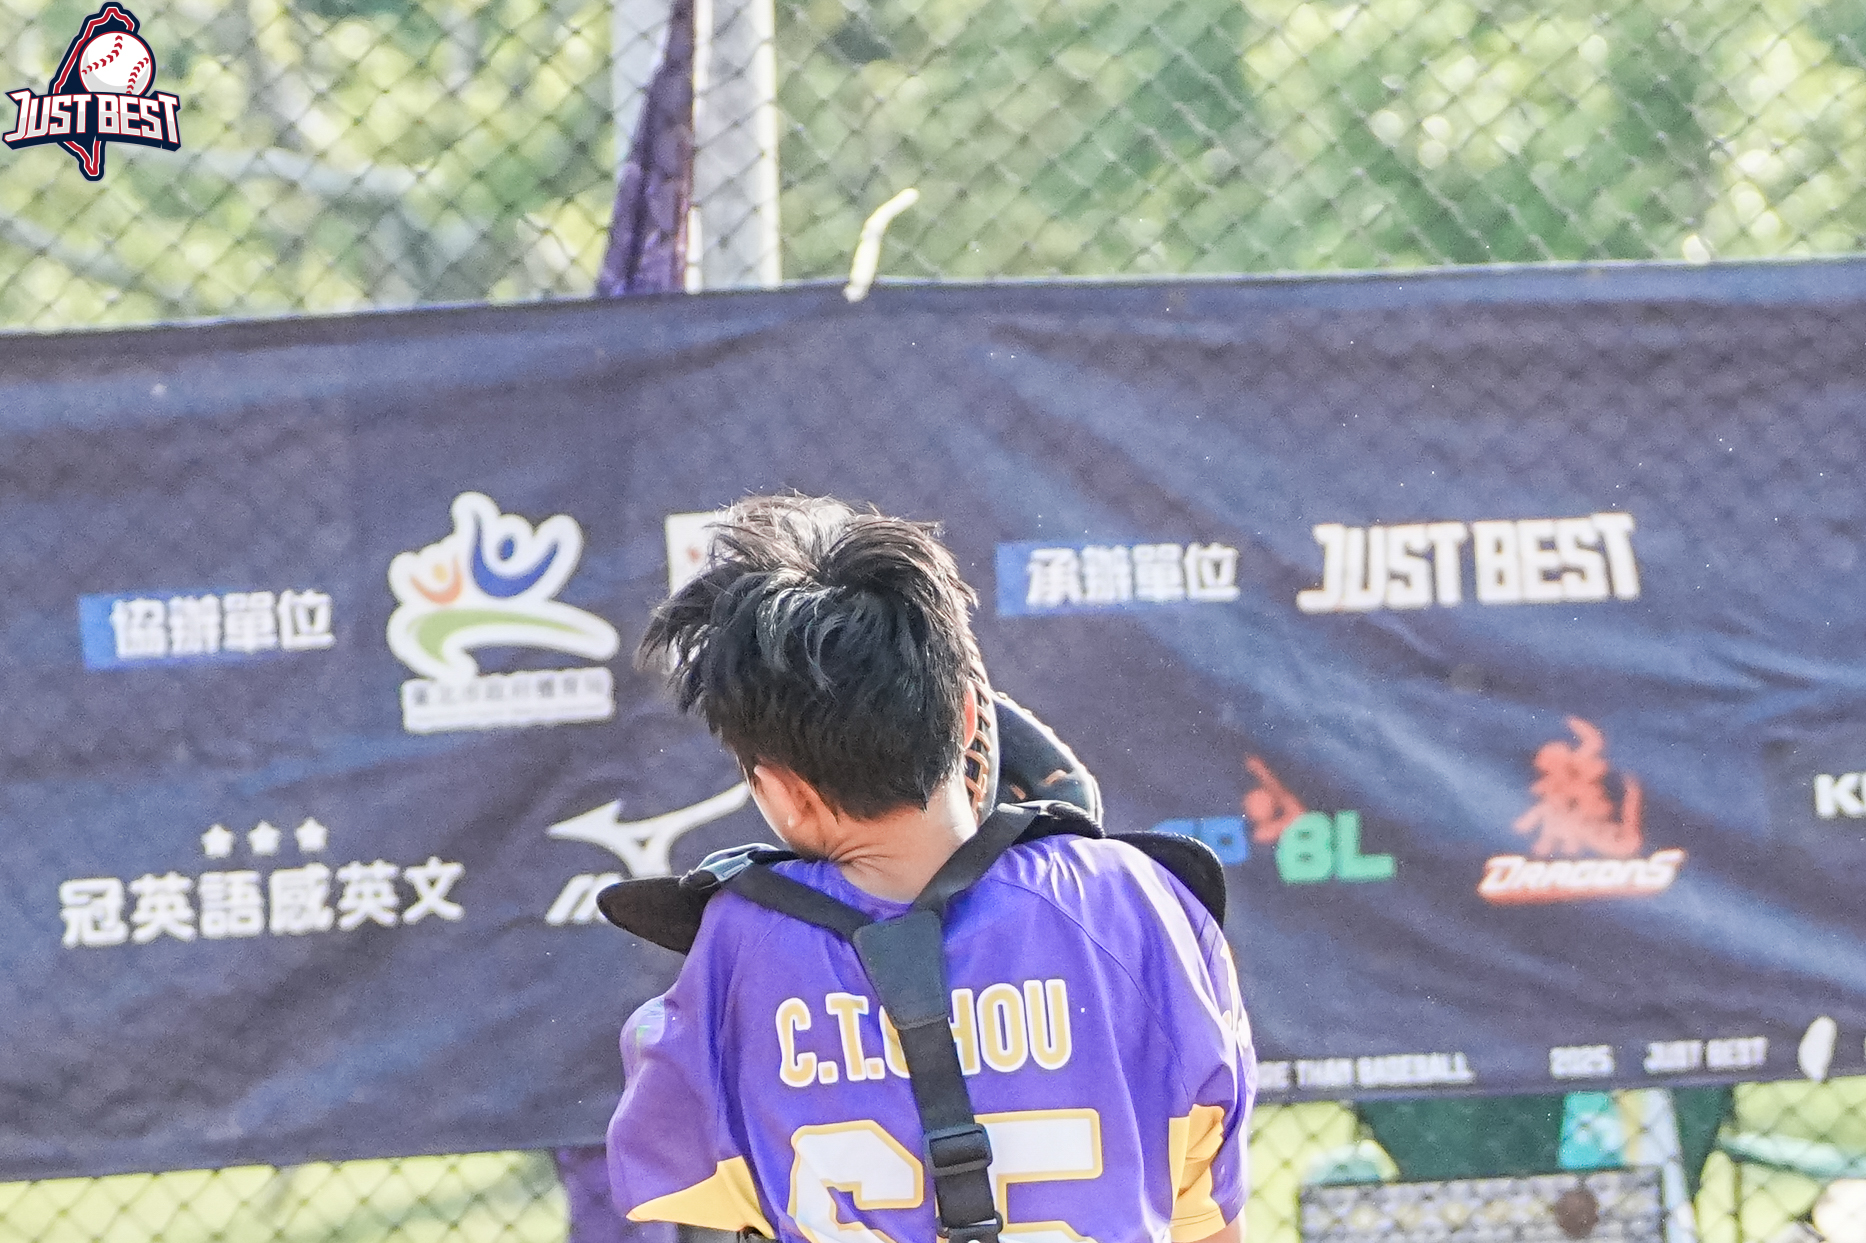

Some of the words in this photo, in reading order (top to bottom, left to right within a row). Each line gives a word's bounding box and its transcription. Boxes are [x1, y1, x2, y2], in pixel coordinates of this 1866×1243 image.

[1026, 543, 1240, 606] 承辦單位
[1297, 522, 1468, 613] JUST
[1472, 513, 1641, 603] BEST
[110, 589, 335, 660] 協辦單位
